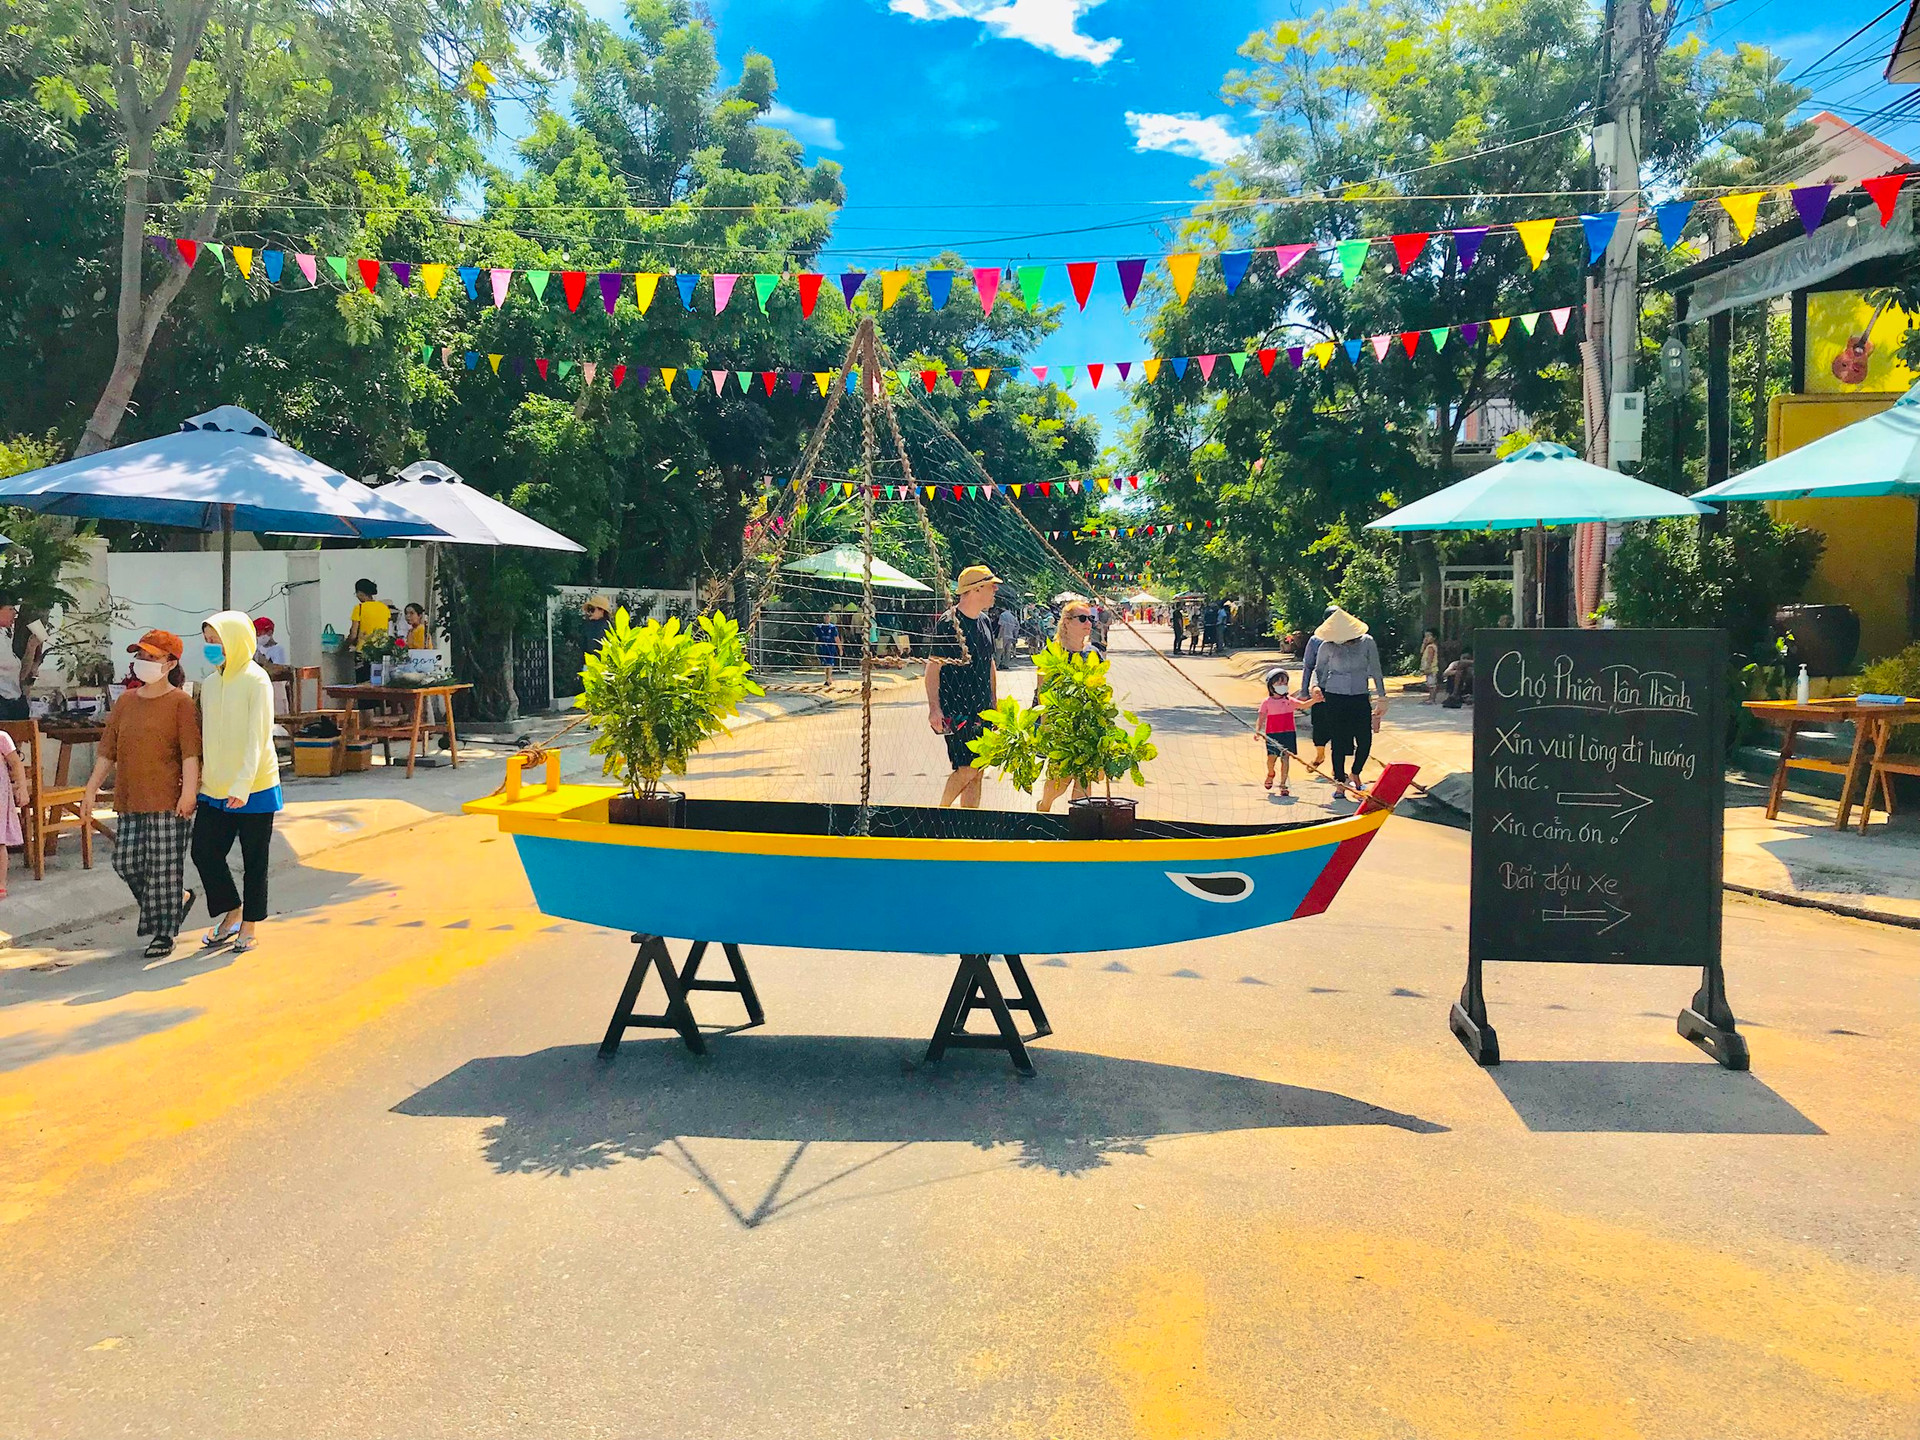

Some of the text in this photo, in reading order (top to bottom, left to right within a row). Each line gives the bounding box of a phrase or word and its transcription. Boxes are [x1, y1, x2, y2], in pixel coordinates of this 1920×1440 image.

[1493, 650, 1693, 710] Chợ Phiên Tân Thành
[1490, 721, 1534, 757] Xin
[1538, 733, 1575, 760] vui
[1621, 735, 1644, 764] đi
[1491, 812, 1528, 837] Xin
[1532, 816, 1576, 843] cảm
[1498, 861, 1537, 890] Bãi
[1541, 862, 1581, 897] đậu
